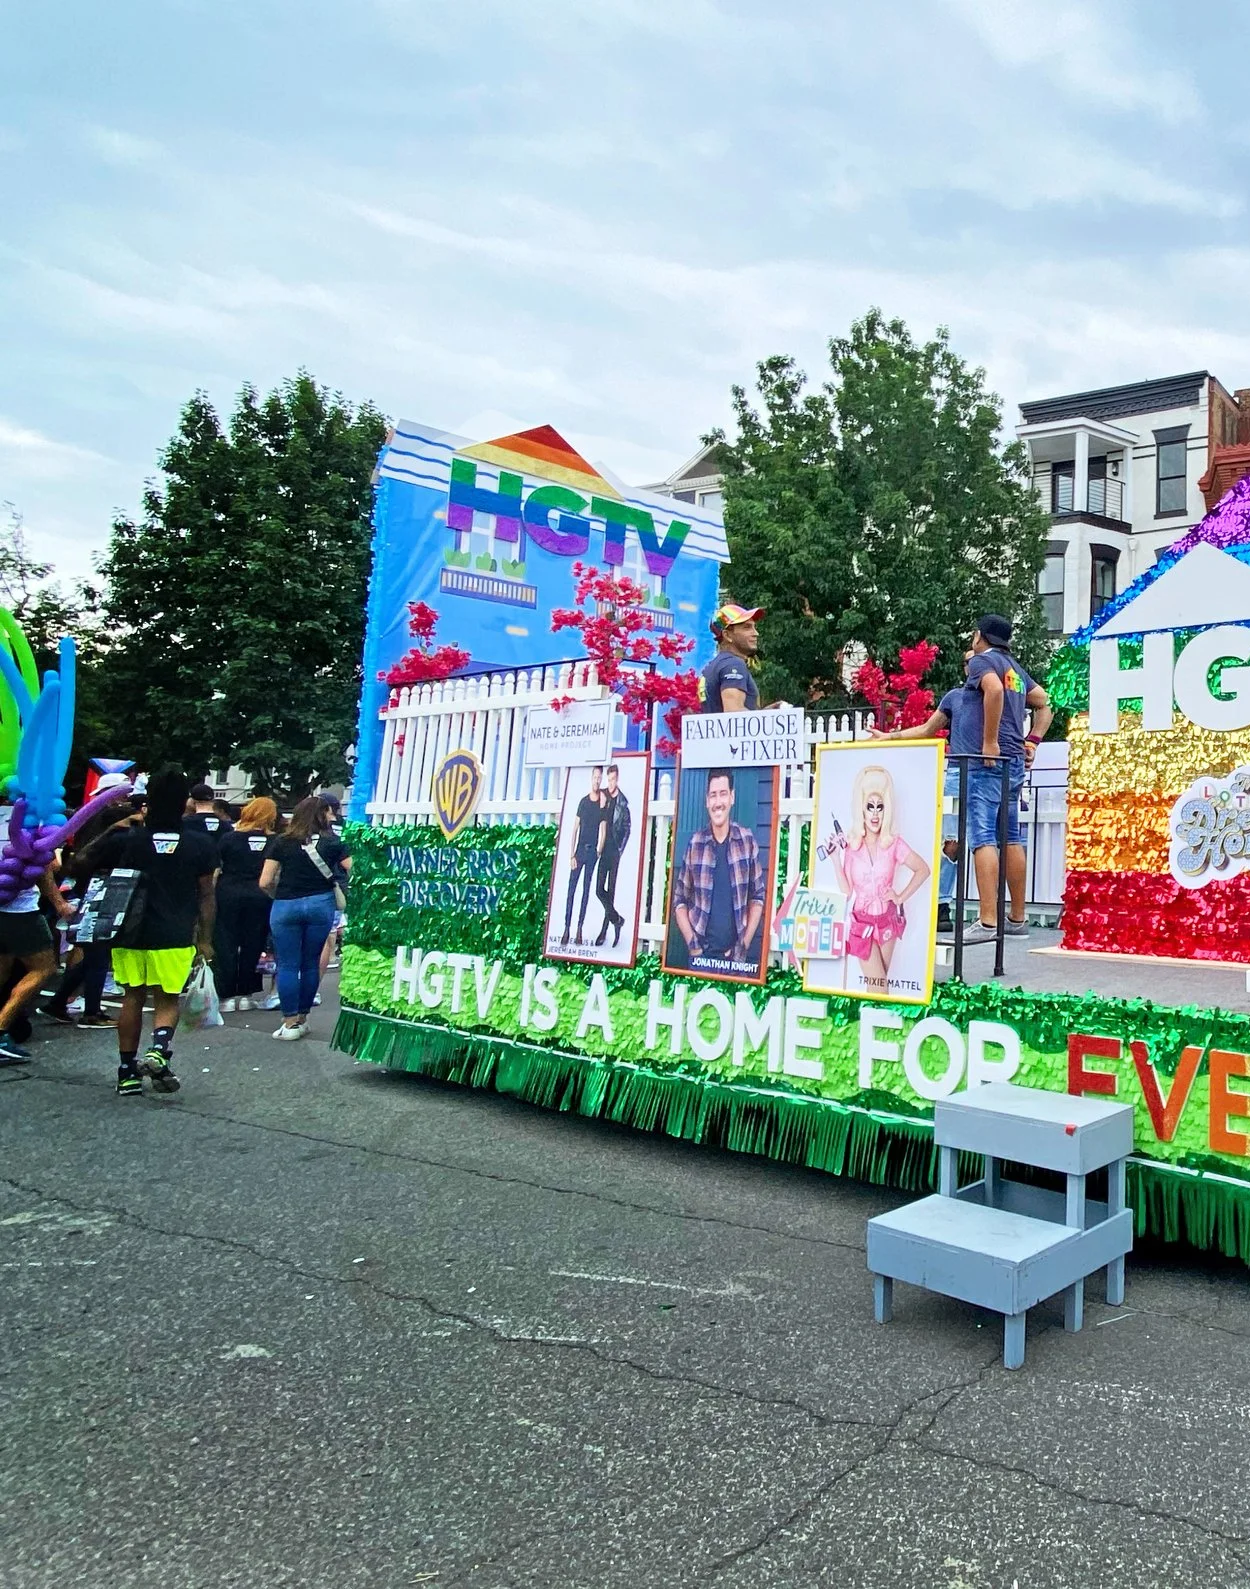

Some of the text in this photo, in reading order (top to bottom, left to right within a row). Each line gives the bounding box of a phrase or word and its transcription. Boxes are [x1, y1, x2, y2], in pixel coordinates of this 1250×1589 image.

[447, 457, 691, 577] HGTV
[530, 722, 606, 740] NATE & JEREMIAH
[684, 713, 799, 741] FARMHOUSE
[740, 738, 798, 762] FIXER
[438, 763, 473, 825] WB
[793, 890, 837, 916] Trixie
[780, 922, 843, 951] MOTEL
[577, 949, 598, 958] BRENT
[692, 956, 759, 973] JONATHAN KNIGHT
[858, 975, 922, 991] TRIXIE MATTEL
[392, 945, 504, 1019] HGTV
[520, 962, 560, 1031] IS
[575, 972, 614, 1043] A
[644, 979, 828, 1081] HOME
[858, 1006, 1022, 1101] FOR
